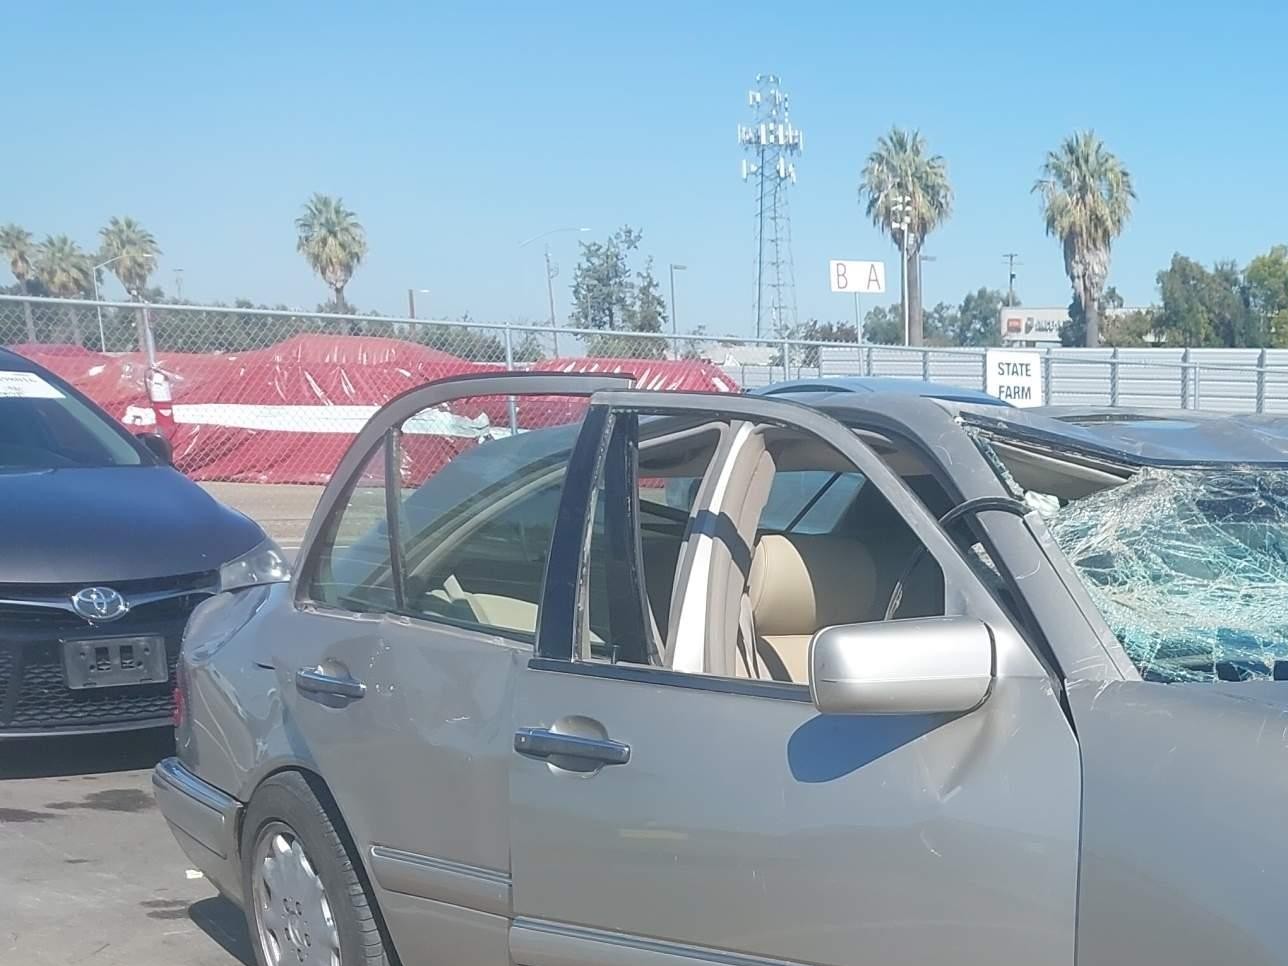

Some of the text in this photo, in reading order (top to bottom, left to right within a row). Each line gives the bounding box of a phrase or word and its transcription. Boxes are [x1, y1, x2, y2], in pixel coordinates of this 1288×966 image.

[836, 262, 881, 290] B A
[998, 361, 1031, 377] STATE
[999, 384, 1031, 400] FARM
